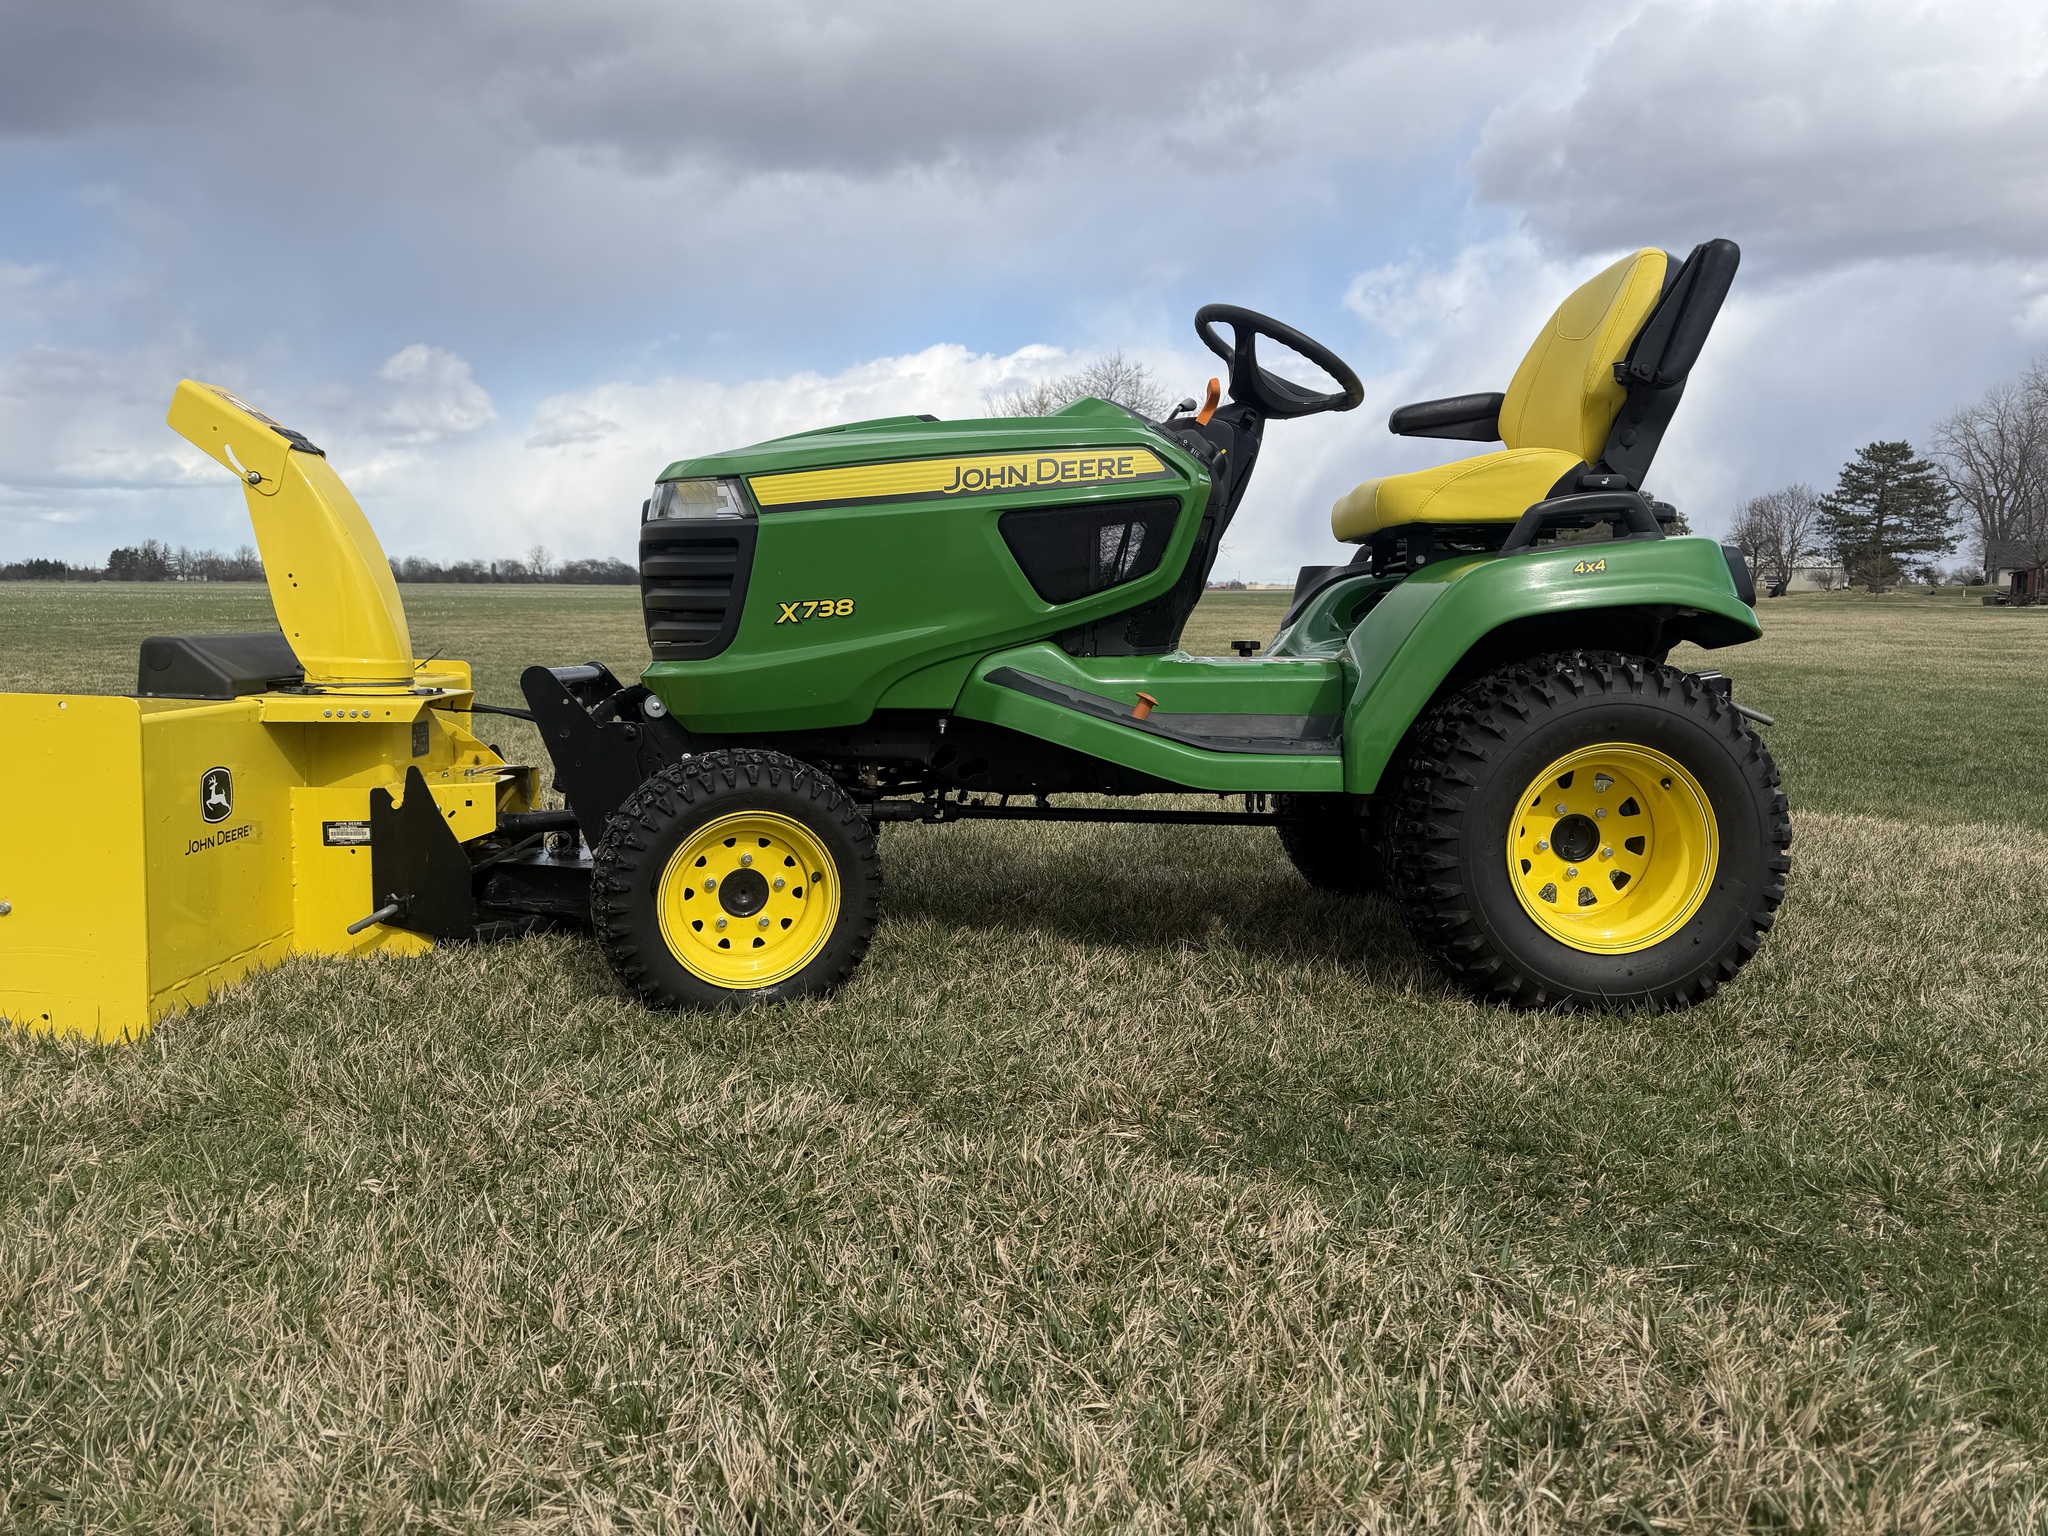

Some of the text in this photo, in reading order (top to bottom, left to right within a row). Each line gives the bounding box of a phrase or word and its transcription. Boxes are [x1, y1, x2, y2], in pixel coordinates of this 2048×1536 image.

[943, 456, 1135, 492] JOHN DEERE
[1573, 559, 1606, 574] 4x4
[775, 598, 854, 623] X738
[185, 825, 250, 856] JOHN DEERE
